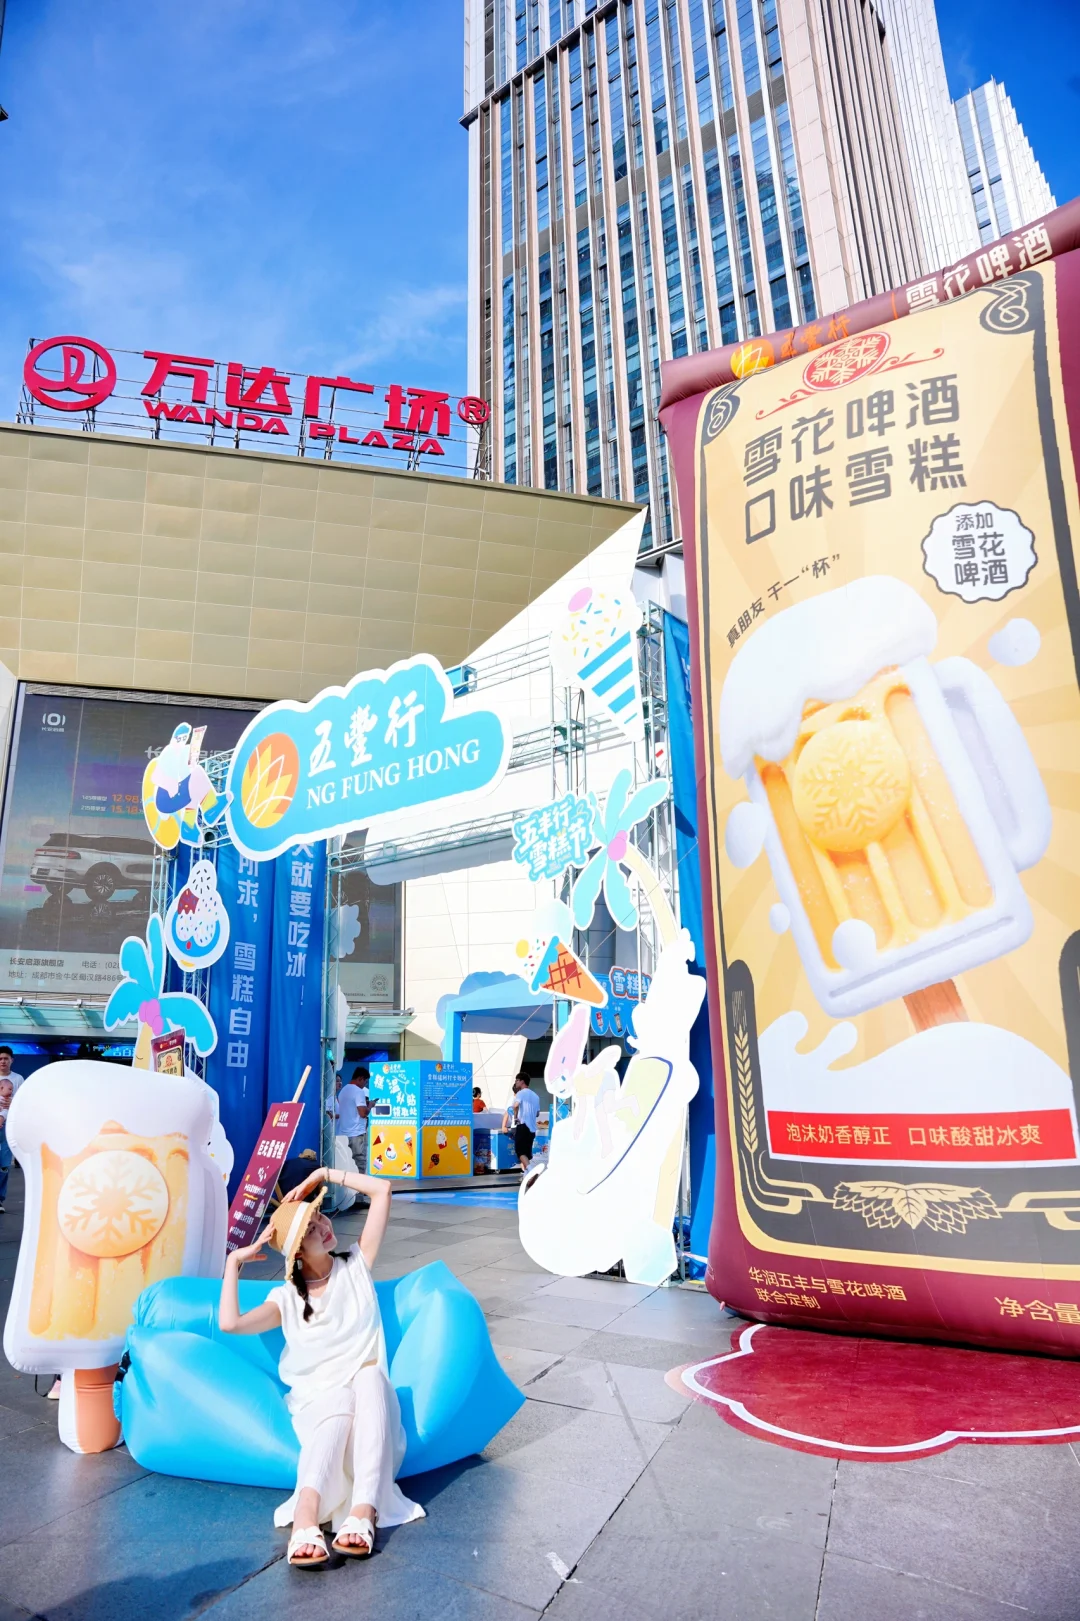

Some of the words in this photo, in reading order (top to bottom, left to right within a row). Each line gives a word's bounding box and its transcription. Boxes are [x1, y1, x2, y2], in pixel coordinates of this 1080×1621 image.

[906, 222, 1053, 314] 雪花啤酒
[141, 350, 451, 436] 万达广场
[143, 400, 289, 435] WANDA
[309, 422, 445, 456] PLAZA
[743, 373, 960, 487] 雪花啤酒
[745, 431, 967, 546] 口味雪糕
[952, 531, 1006, 560] 雪花
[955, 512, 994, 532] 添加
[954, 559, 1009, 587] 啤酒
[306, 781, 336, 809] NG
[340, 762, 401, 799] FUNG
[407, 739, 481, 781] HONG
[520, 802, 572, 853] 五丰行
[530, 818, 586, 873] 雪糕节
[786, 1123, 892, 1145] 泡沫奶香醇正
[908, 1123, 1043, 1147] 口味酸甜冰爽
[748, 1266, 907, 1301] 华润五丰与雪花啤酒
[755, 1287, 821, 1309] 联合定制
[994, 1296, 1080, 1325] 净含量
